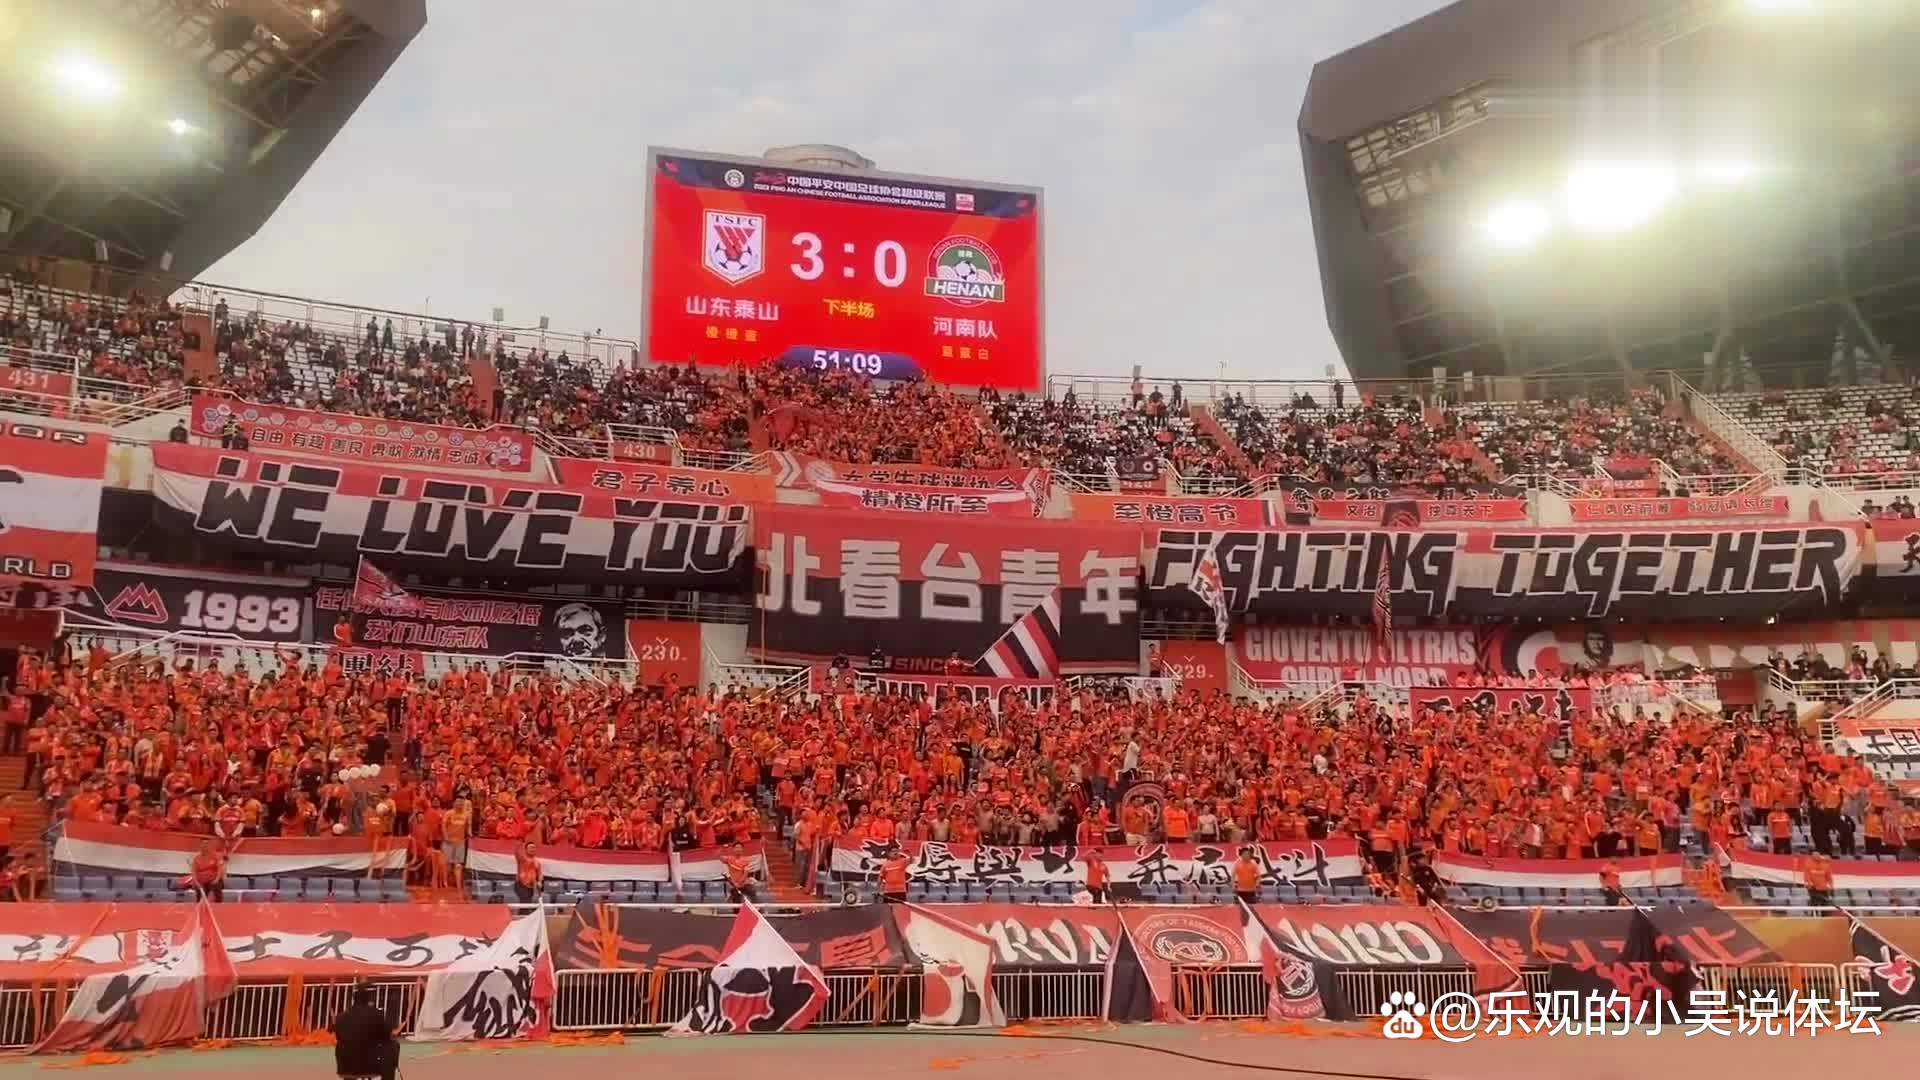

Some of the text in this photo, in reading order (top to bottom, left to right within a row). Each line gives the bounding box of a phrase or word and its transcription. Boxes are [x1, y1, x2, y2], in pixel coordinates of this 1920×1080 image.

[824, 190, 857, 199] FOOTBALL
[933, 280, 996, 298] HENAN
[686, 295, 779, 321] 山东泰山
[823, 299, 875, 318] 下半场
[933, 316, 998, 340] 河南队
[813, 349, 882, 375] 51:09
[8, 370, 50, 388] 431
[251, 427, 282, 444] 自由
[623, 442, 656, 459] 430
[592, 471, 730, 497] 君子养心
[195, 456, 342, 548] WE
[862, 489, 990, 513] 精橙所至
[1113, 502, 1239, 524] 至橙高节
[756, 532, 1140, 625] 北看台青年
[180, 589, 301, 634] 1993
[364, 618, 489, 649] 我们山东队
[1384, 630, 1478, 666] LTRAS
[893, 656, 950, 673] SINC
